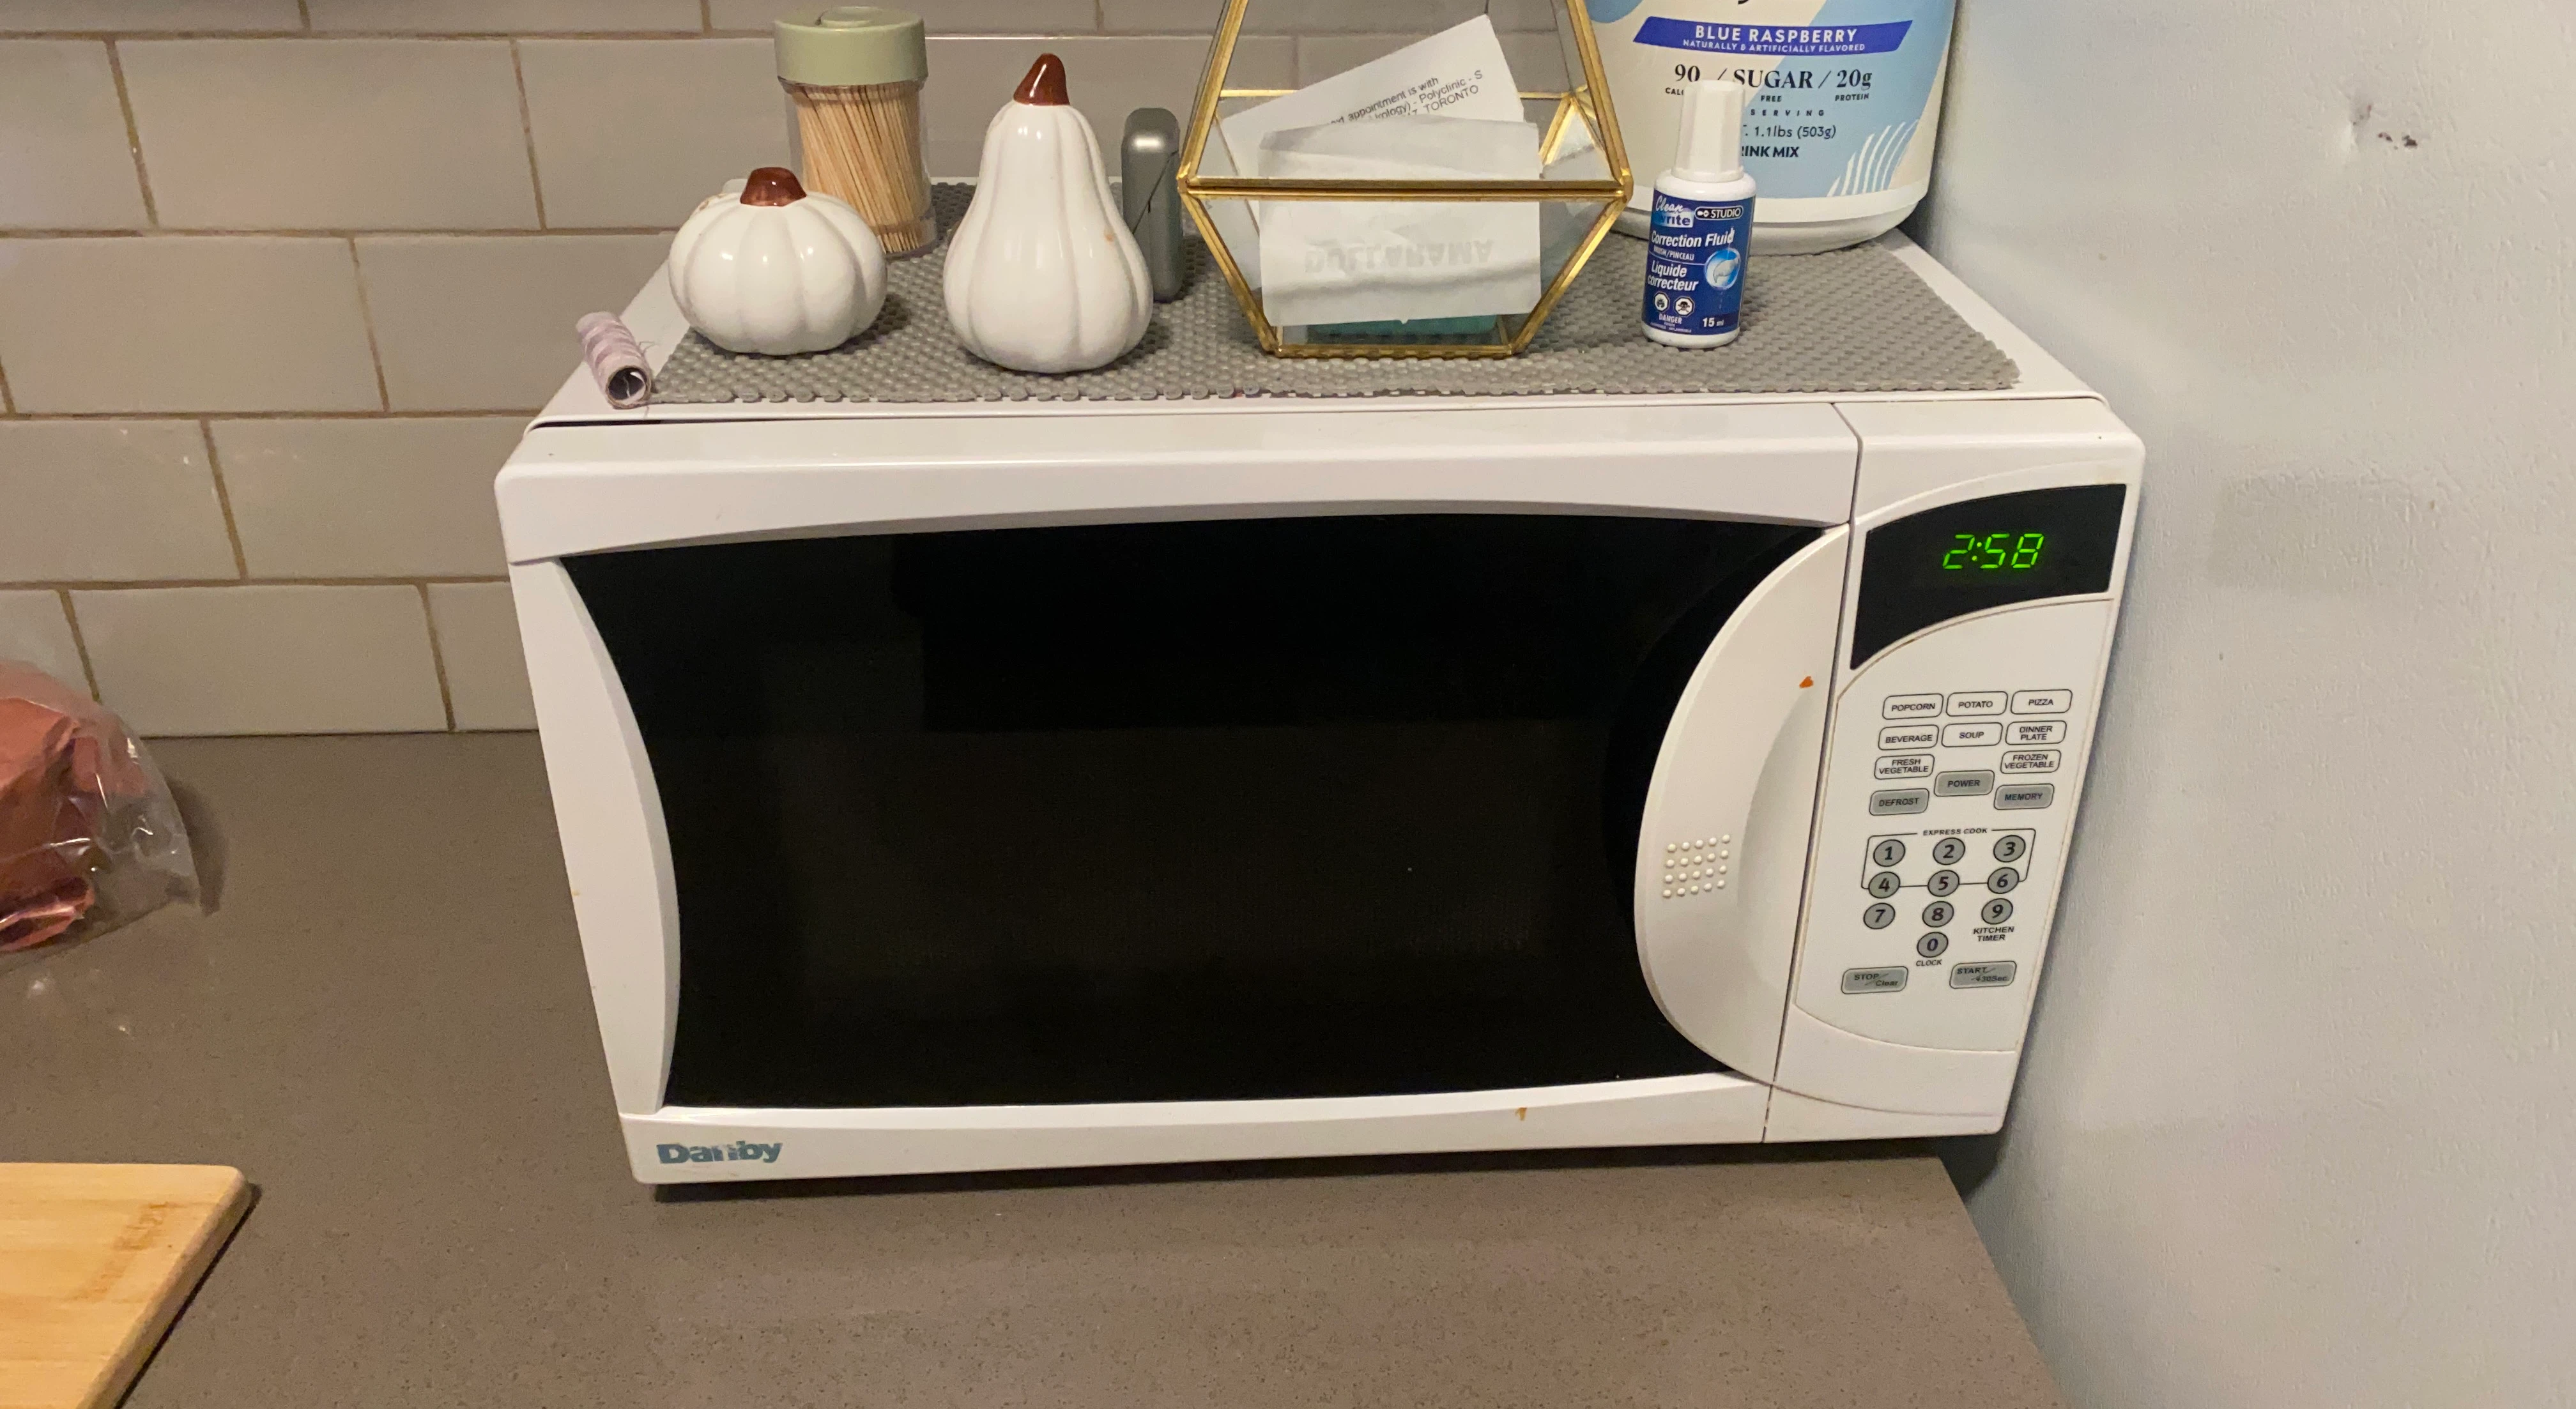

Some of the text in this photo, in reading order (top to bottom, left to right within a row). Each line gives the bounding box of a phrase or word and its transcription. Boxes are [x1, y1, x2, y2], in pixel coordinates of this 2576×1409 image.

[1695, 25, 1857, 43] BLUE RASPBERRY
[1683, 39, 1738, 51] NATURALLY
[1749, 43, 1816, 53] ARTIFICIALLY
[1818, 43, 1866, 52] FLAVORED
[1675, 64, 1701, 82] 90
[1733, 68, 1814, 89] SUGAR
[1836, 68, 1873, 91] 20g
[1418, 79, 1466, 104] Polyclinic
[1423, 84, 1479, 113] TORONTO
[1834, 93, 1869, 102] PROTEIN
[1348, 90, 1407, 121] appointment
[1408, 87, 1417, 96] is
[1418, 77, 1439, 91] with
[1754, 125, 1793, 137] 1.1lbs
[1797, 126, 1837, 140] (503g)
[1742, 146, 1800, 158] INK MIX
[1655, 195, 1684, 214] Clean
[1710, 208, 1742, 218] STUDIO
[1651, 227, 1735, 248] Correction Fluid
[1651, 259, 1687, 278] Liquide
[1647, 275, 1699, 291] correcteur
[1659, 313, 1683, 324] DANGER
[1702, 317, 1715, 328] 15
[1942, 533, 2045, 570] 2:58
[1891, 703, 1936, 712] POPCORN
[1958, 700, 1994, 709] POTATO
[2028, 698, 2055, 706] PIZZA
[1959, 731, 1984, 740] SOUP
[2019, 725, 2053, 734] DINNER
[1885, 734, 1933, 744] BEVERAGE
[1891, 758, 1922, 766] FRESH
[2004, 760, 2055, 769] VEGETABLE
[1879, 765, 1929, 775] VEGETABLE
[1947, 779, 1981, 788] POWER
[1878, 797, 1920, 807] DEFROST
[2004, 792, 2044, 801] MEMORY
[1884, 846, 1893, 861] 1
[1943, 844, 1955, 859] 2
[2002, 841, 2016, 857] 3
[1878, 877, 1891, 892] 4
[1938, 876, 1949, 891] 5
[1997, 873, 2009, 888] 6
[1874, 908, 1887, 924] 7
[1931, 907, 1945, 922] 8
[1993, 903, 2004, 918] 9
[1973, 925, 2015, 934] KITCHEN
[1926, 938, 1938, 952] 0
[1977, 934, 2006, 942] TIMER
[1915, 959, 1943, 967] CLOCK
[1854, 973, 1880, 981] STOP
[1957, 966, 1988, 975] START
[656, 1140, 784, 1164] Danby
